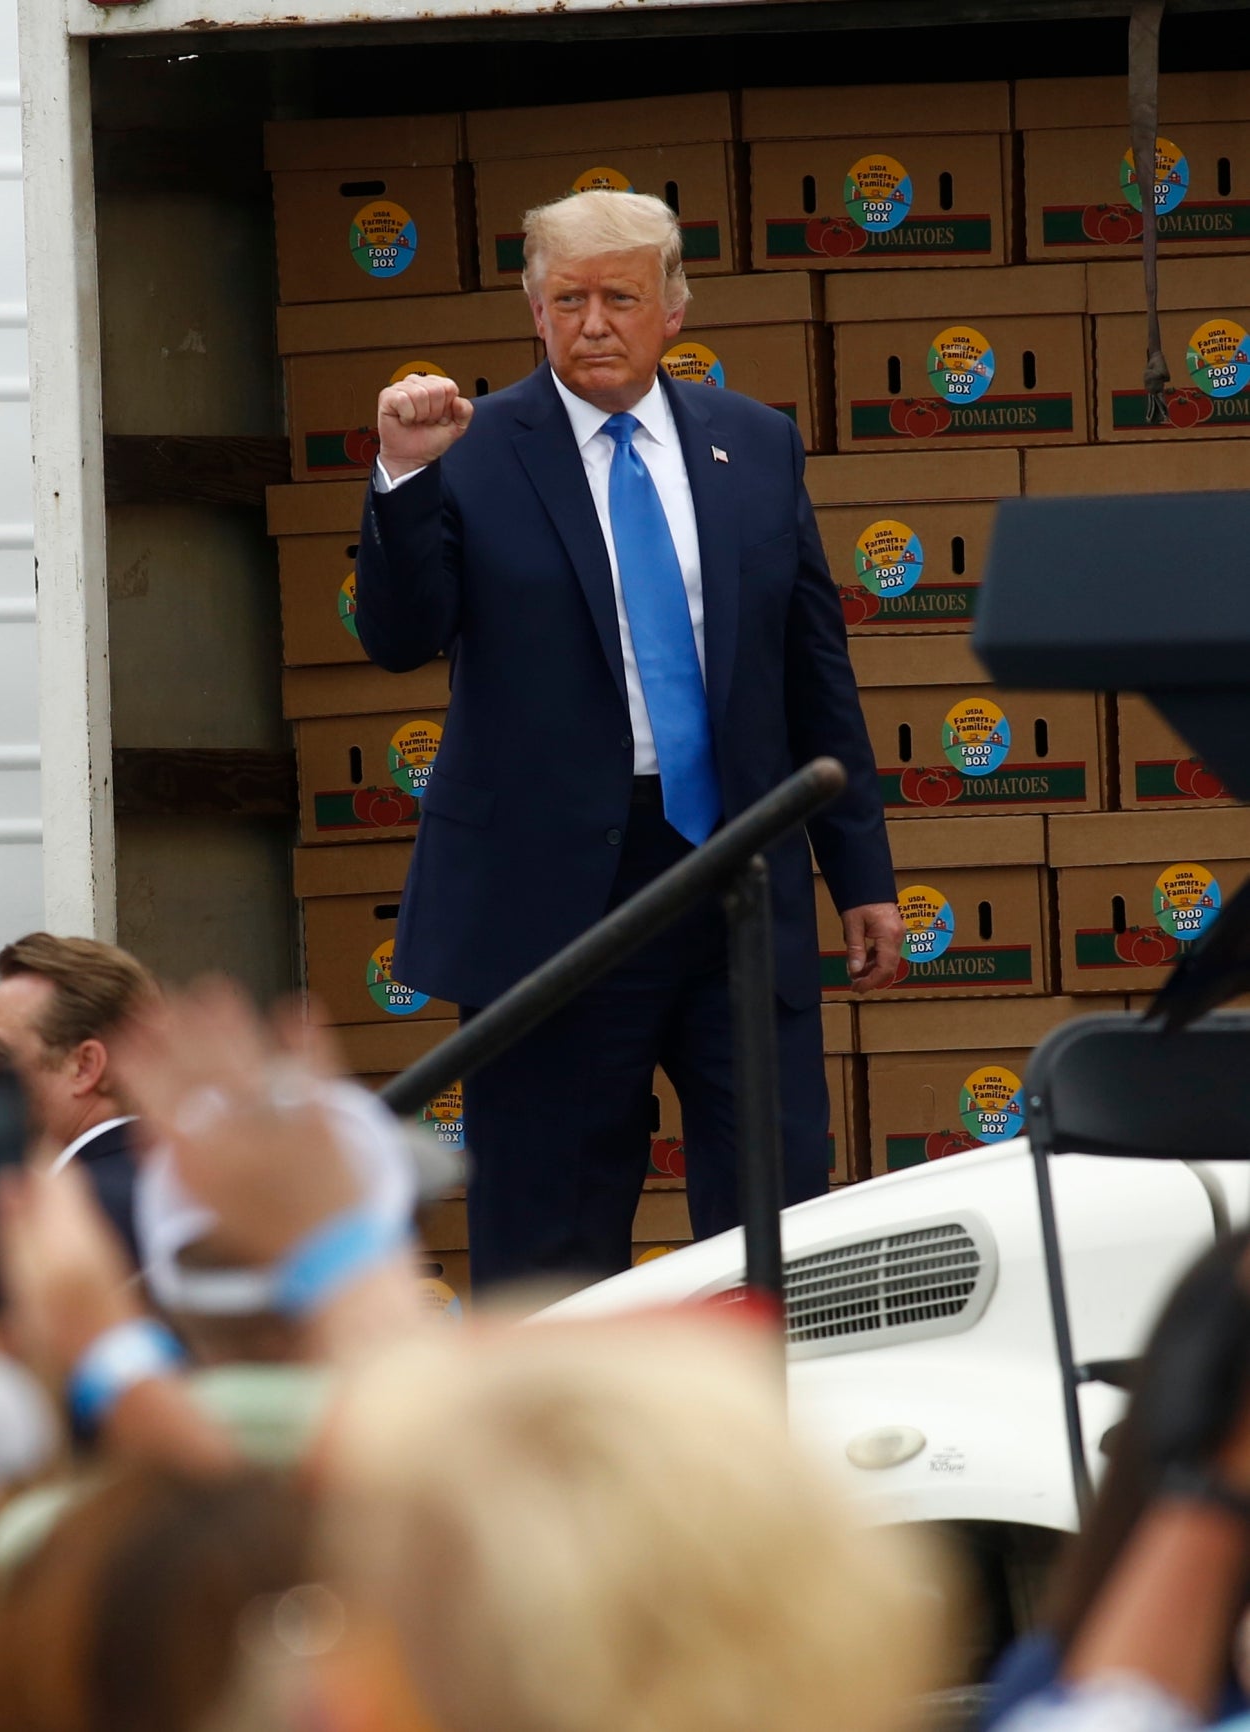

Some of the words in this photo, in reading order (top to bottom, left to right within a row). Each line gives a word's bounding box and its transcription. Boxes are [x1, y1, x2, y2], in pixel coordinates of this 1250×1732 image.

[857, 172, 892, 180] Farmers
[859, 180, 895, 189] Families
[1154, 184, 1169, 193] OD
[863, 202, 893, 211] FOOD
[866, 213, 888, 221] BOX
[362, 219, 396, 227] Farmers
[1156, 213, 1233, 232] OMATOES
[364, 226, 399, 234] Families
[869, 227, 955, 246] TOMATOES
[368, 248, 398, 257] FOOD
[372, 258, 395, 268] BOX
[940, 343, 975, 351] Farmers
[1197, 336, 1231, 349] Farmers
[1200, 345, 1236, 356] Families
[942, 351, 977, 361] Families
[667, 360, 702, 370] Farmers
[670, 368, 706, 378] Families
[1208, 365, 1237, 378] FOOD
[945, 373, 973, 383] FOOD
[1213, 376, 1235, 388] BOX
[948, 384, 971, 394] BOX
[951, 407, 1037, 426] TOMATOES
[875, 530, 892, 538] USDA
[865, 537, 898, 549] Farmers
[869, 545, 903, 556] Families
[876, 565, 905, 579] FOOD
[880, 576, 903, 589] BOX
[880, 594, 967, 612] TOMATOES
[953, 715, 989, 725] Farmers
[956, 723, 992, 733] Families
[398, 737, 433, 748] Farmers
[401, 744, 437, 755] Families
[961, 745, 992, 756] FOOD
[965, 756, 988, 766] BOX
[412, 778, 430, 788] BO
[962, 776, 1049, 796] TOMATOES
[1164, 880, 1199, 889] Farmers
[1166, 887, 1203, 897] Families
[898, 903, 932, 912] Farmers
[900, 910, 936, 920] Families
[1172, 909, 1203, 920] FOOD
[1177, 920, 1199, 930] BOX
[906, 932, 935, 943] FOOD
[910, 942, 932, 953] BOX
[910, 957, 996, 976] TOMATOES
[389, 996, 411, 1005] BOX
[972, 1083, 1007, 1092] Farmers
[974, 1091, 1010, 1101] Families
[978, 1113, 1008, 1123] FOOD
[434, 1123, 463, 1132] FOOD
[981, 1124, 1005, 1133] BOX
[438, 1133, 459, 1142] BOX
